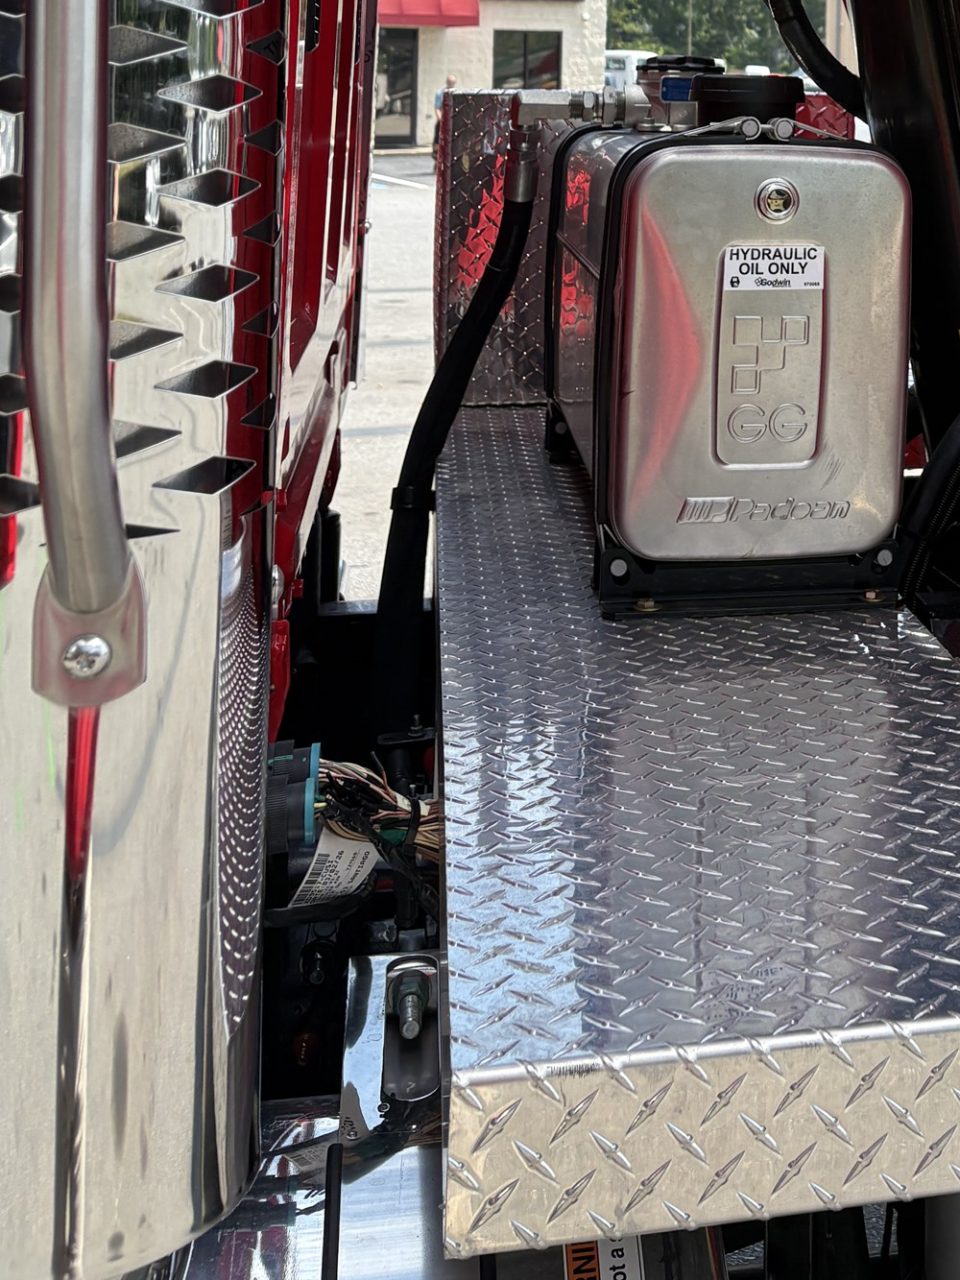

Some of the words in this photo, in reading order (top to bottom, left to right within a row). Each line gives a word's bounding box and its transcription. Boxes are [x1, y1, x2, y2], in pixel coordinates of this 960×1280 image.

[729, 247, 817, 261] HYDRAULIC
[739, 262, 764, 275] OIL
[768, 262, 808, 275] ONLY
[760, 278, 791, 287] Godwin
